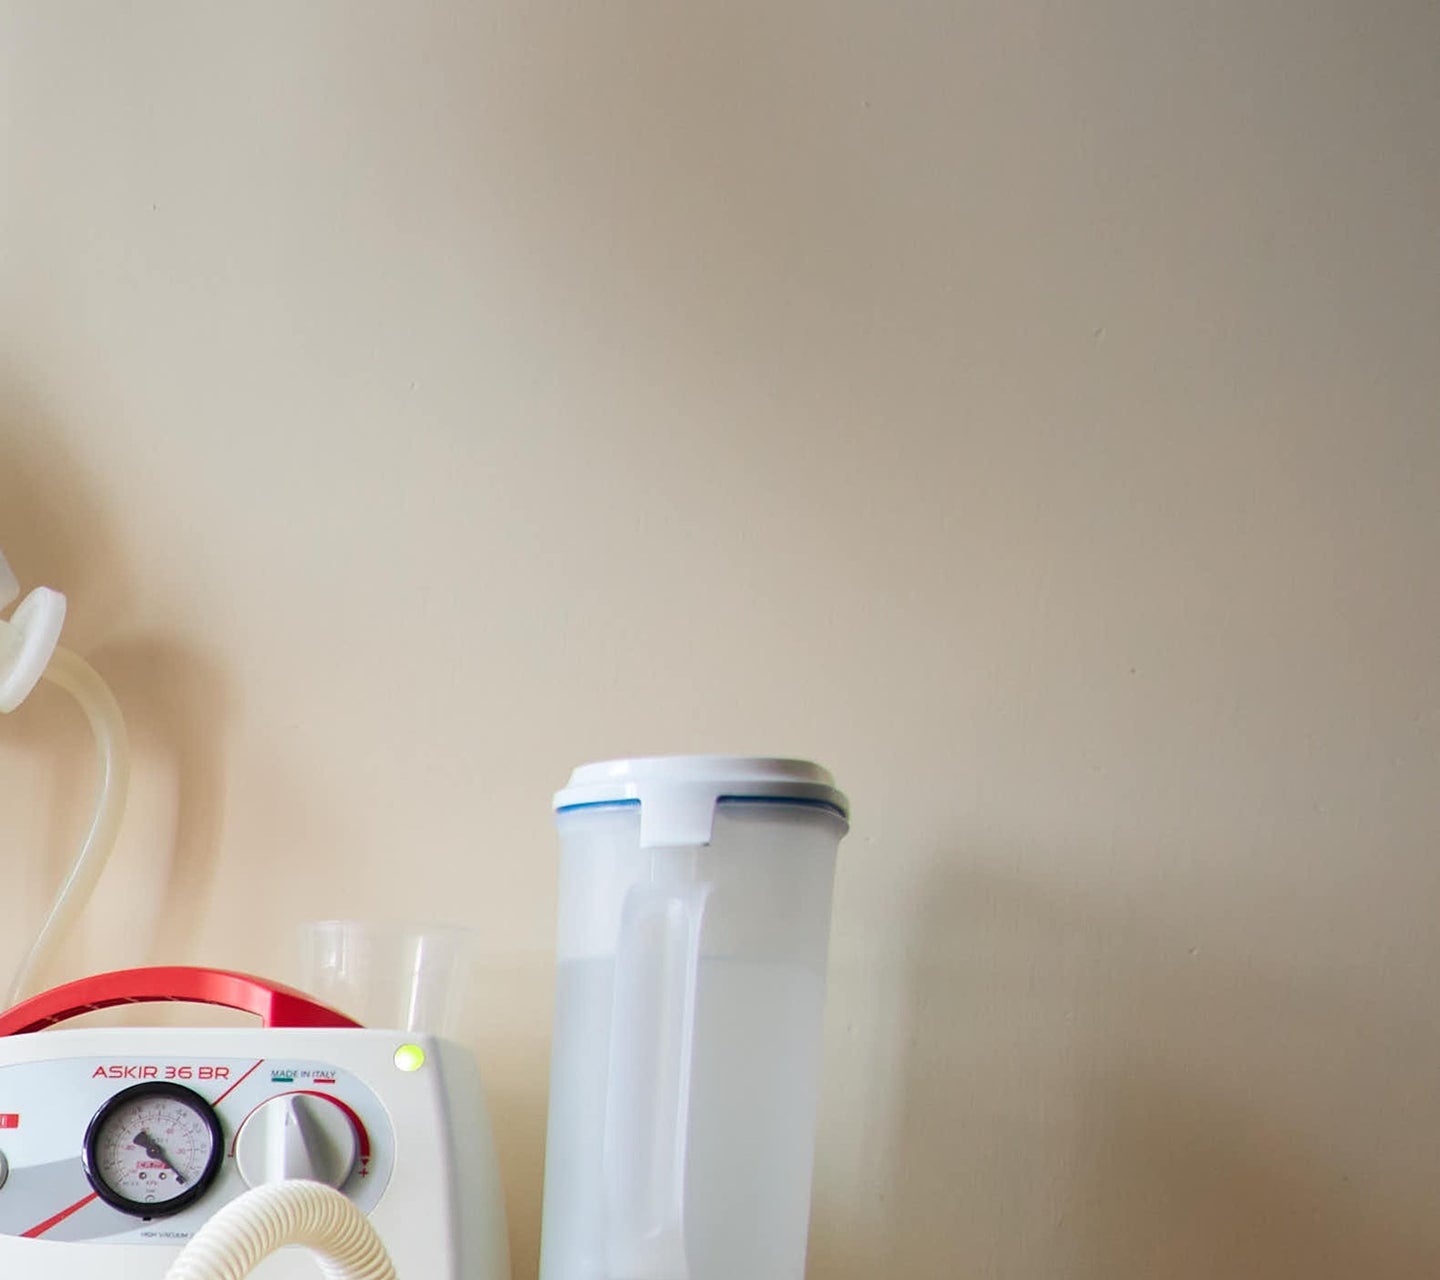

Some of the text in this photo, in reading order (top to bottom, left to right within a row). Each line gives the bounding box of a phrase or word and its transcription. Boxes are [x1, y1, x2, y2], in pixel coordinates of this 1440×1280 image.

[92, 1065, 230, 1081] ASKIR 36 BR
[270, 1069, 336, 1080] MADE IN ITALY
